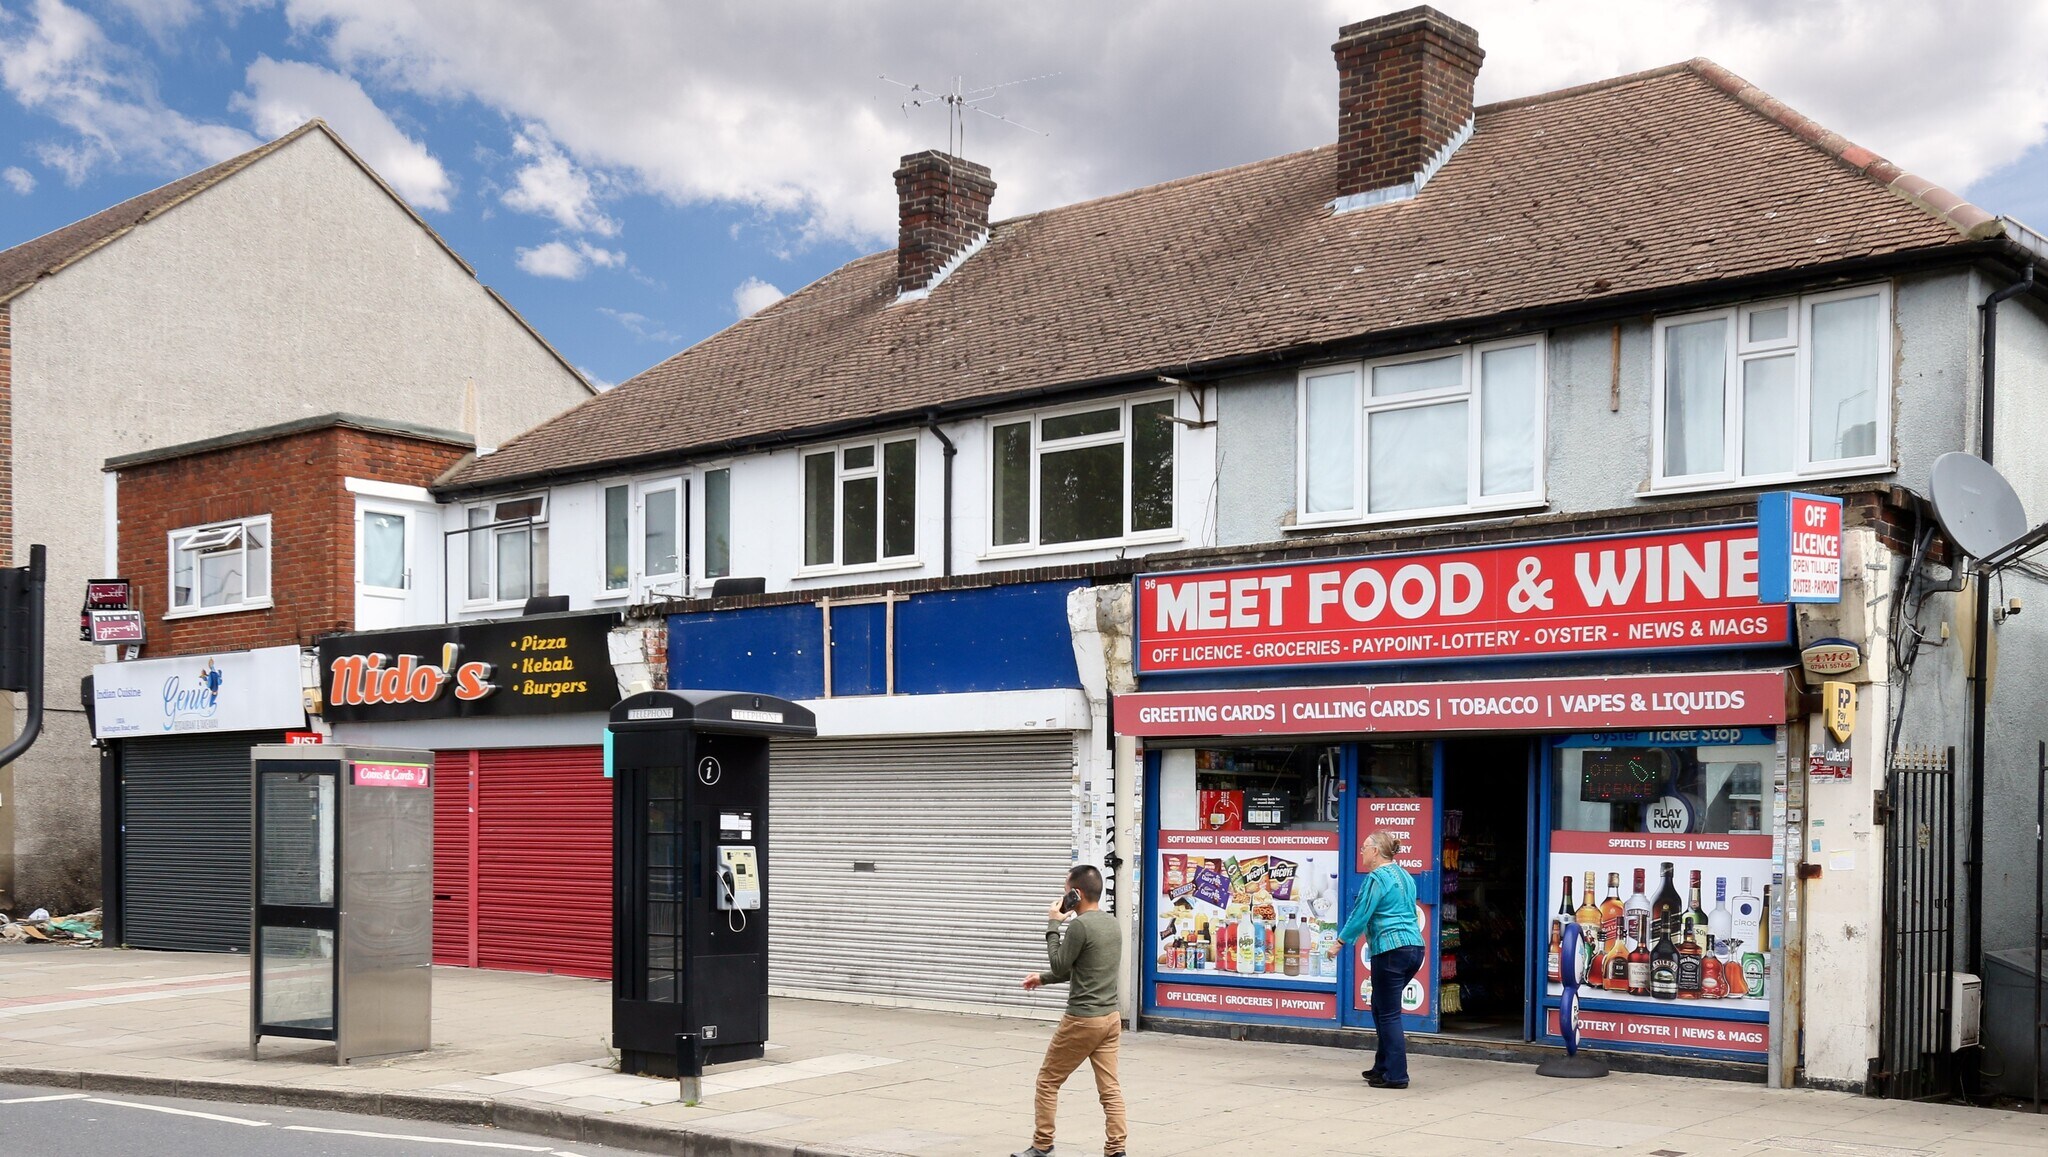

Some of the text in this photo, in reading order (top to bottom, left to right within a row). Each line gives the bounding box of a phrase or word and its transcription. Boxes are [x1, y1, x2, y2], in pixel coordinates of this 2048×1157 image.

[1804, 505, 1827, 528] OFF
[1793, 531, 1838, 556] LICENCE
[1792, 559, 1838, 574] OPEN TILL LATE
[1144, 579, 1156, 590] 96
[1156, 537, 1759, 633] MEET FOOD & WINE
[1792, 578, 1811, 593] OYSTER
[1814, 580, 1838, 594] PAYPOINT
[521, 635, 567, 651] Pizza
[1152, 647, 1179, 664] OFF
[1182, 644, 1243, 662] LICENCE
[1253, 639, 1340, 658] GROCERIES
[1352, 635, 1433, 654] PAYPOINT
[1442, 629, 1519, 650] LOTTERY
[1534, 625, 1607, 645] OYSTER
[1628, 621, 1684, 640] NEWS
[1689, 620, 1703, 638] &
[1710, 617, 1768, 636] MAGS
[521, 656, 574, 673] Kebab
[96, 687, 141, 700] Indian Cuisine
[522, 679, 587, 698] Burgers
[163, 675, 210, 731] Genie
[1139, 706, 1217, 724] GREETING
[1220, 703, 1275, 721] CARDS
[1292, 701, 1366, 719] CALLING
[1370, 699, 1430, 718] CARDS
[1448, 696, 1539, 715] TOBACCO
[1560, 694, 1626, 713] VAPES
[1630, 693, 1647, 711] &
[1652, 690, 1745, 715] LIQUIDS
[632, 708, 673, 719] TELEPHONE
[733, 710, 779, 722] TELEPHONE
[1837, 709, 1846, 723] Pay
[1837, 721, 1850, 732] Point
[292, 736, 318, 745] JUST
[1648, 729, 1697, 742] Ticket
[1701, 728, 1741, 744] Stop
[360, 767, 382, 780] Coins
[391, 769, 414, 781] Cards
[1589, 763, 1624, 777] OFF
[1588, 783, 1651, 795] LICENCE
[1370, 803, 1420, 811] OFF LICENCE
[1653, 808, 1682, 819] PLAY
[1374, 817, 1415, 826] PAYPOINT
[1653, 819, 1682, 829] NOW
[1167, 836, 1184, 844] SOFT
[1186, 836, 1213, 844] DRINKS
[1220, 836, 1261, 844] GROCERIES
[1268, 836, 1329, 845] CONFECTIONERY
[1608, 839, 1646, 848] SPIRITS
[1656, 840, 1686, 849] BEERS
[1696, 841, 1730, 850] WINES
[1399, 860, 1422, 868] MAGS
[1166, 991, 1182, 1000] OFF
[1182, 992, 1217, 1003] LICENCE
[1225, 995, 1273, 1006] GROCERIES
[1281, 999, 1326, 1011] PAYPOINT
[1578, 1020, 1616, 1032] OTTERY
[1628, 1023, 1670, 1036] OYSTER
[1682, 1028, 1715, 1040] NEWS
[1717, 1030, 1727, 1041] &
[1728, 1031, 1763, 1044] MAGS
